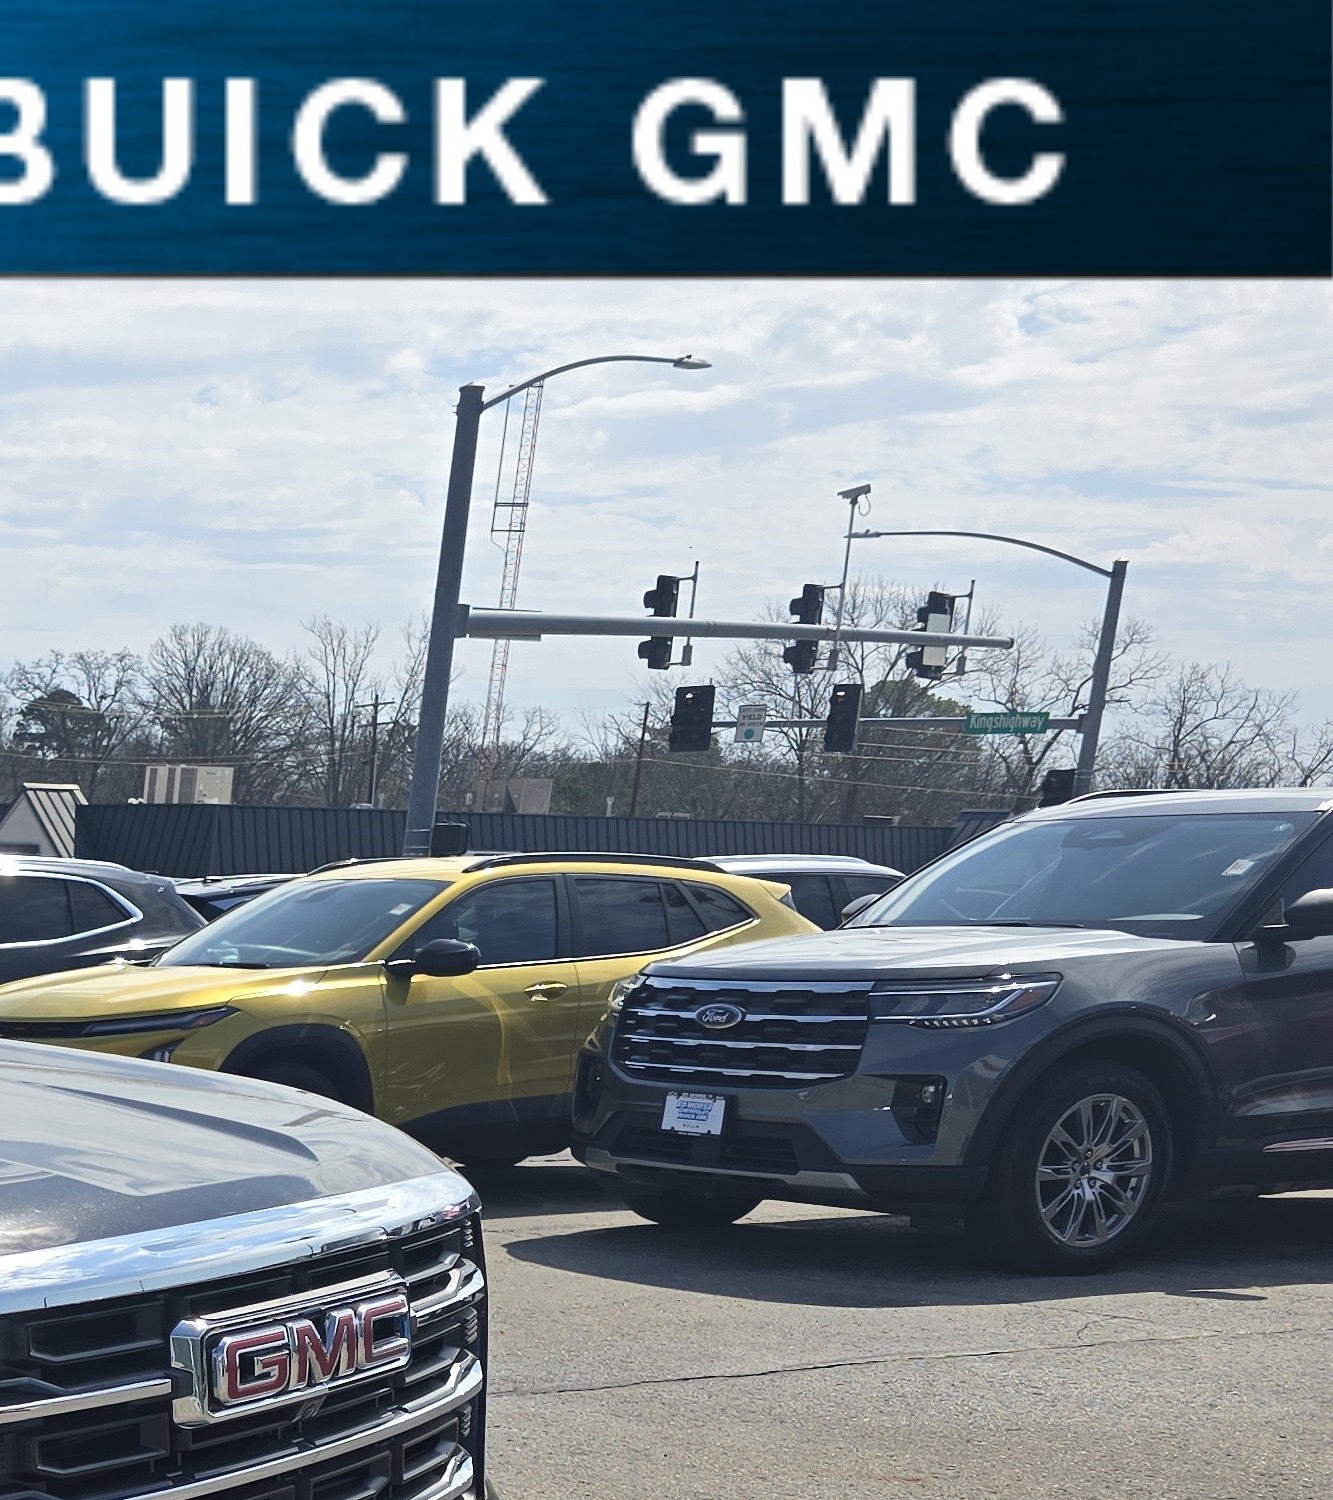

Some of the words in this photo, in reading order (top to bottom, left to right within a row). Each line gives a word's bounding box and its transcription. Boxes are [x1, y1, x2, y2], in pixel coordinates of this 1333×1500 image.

[969, 713, 1044, 732] Kingshighway
[701, 1008, 729, 1023] Ford
[213, 1293, 412, 1406] GMC
